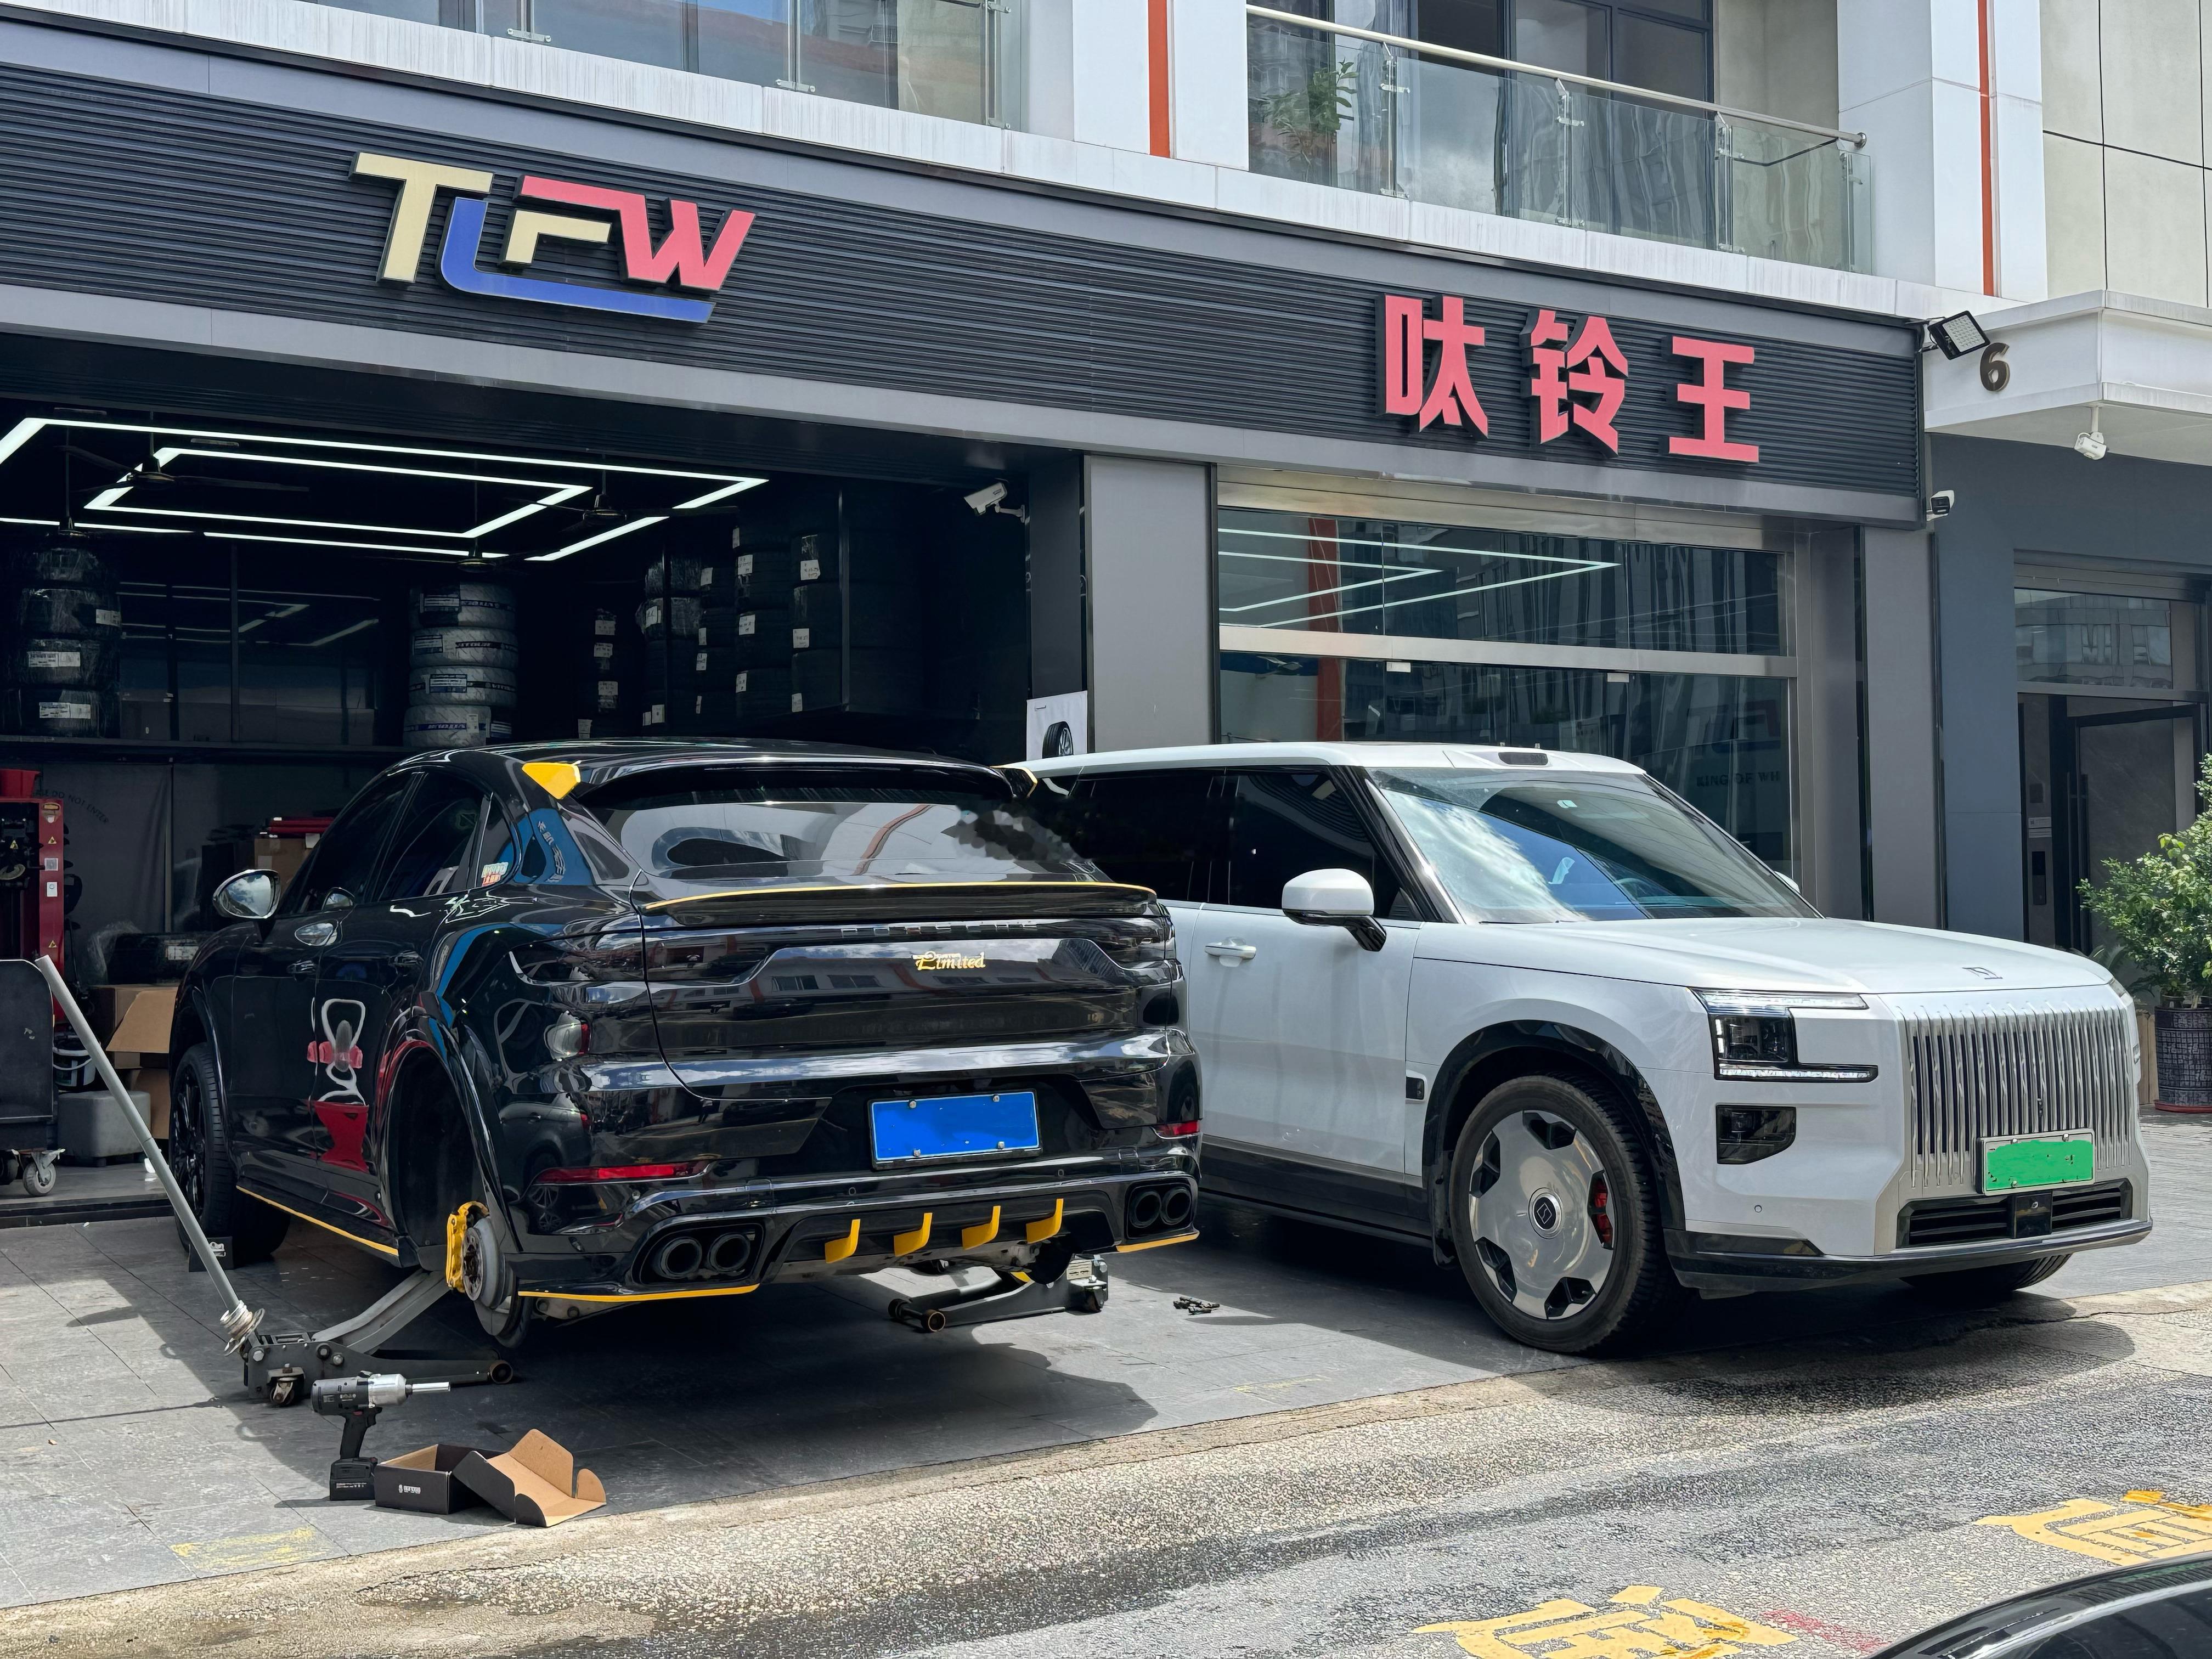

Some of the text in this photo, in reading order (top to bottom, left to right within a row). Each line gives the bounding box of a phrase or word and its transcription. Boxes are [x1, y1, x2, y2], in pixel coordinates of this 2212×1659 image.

[1383, 294, 1760, 463] 呔铃王
[1979, 342, 2011, 392] 6
[1696, 774, 1729, 787] KING
[1735, 772, 1754, 785] OF
[69, 794, 86, 806] NOT
